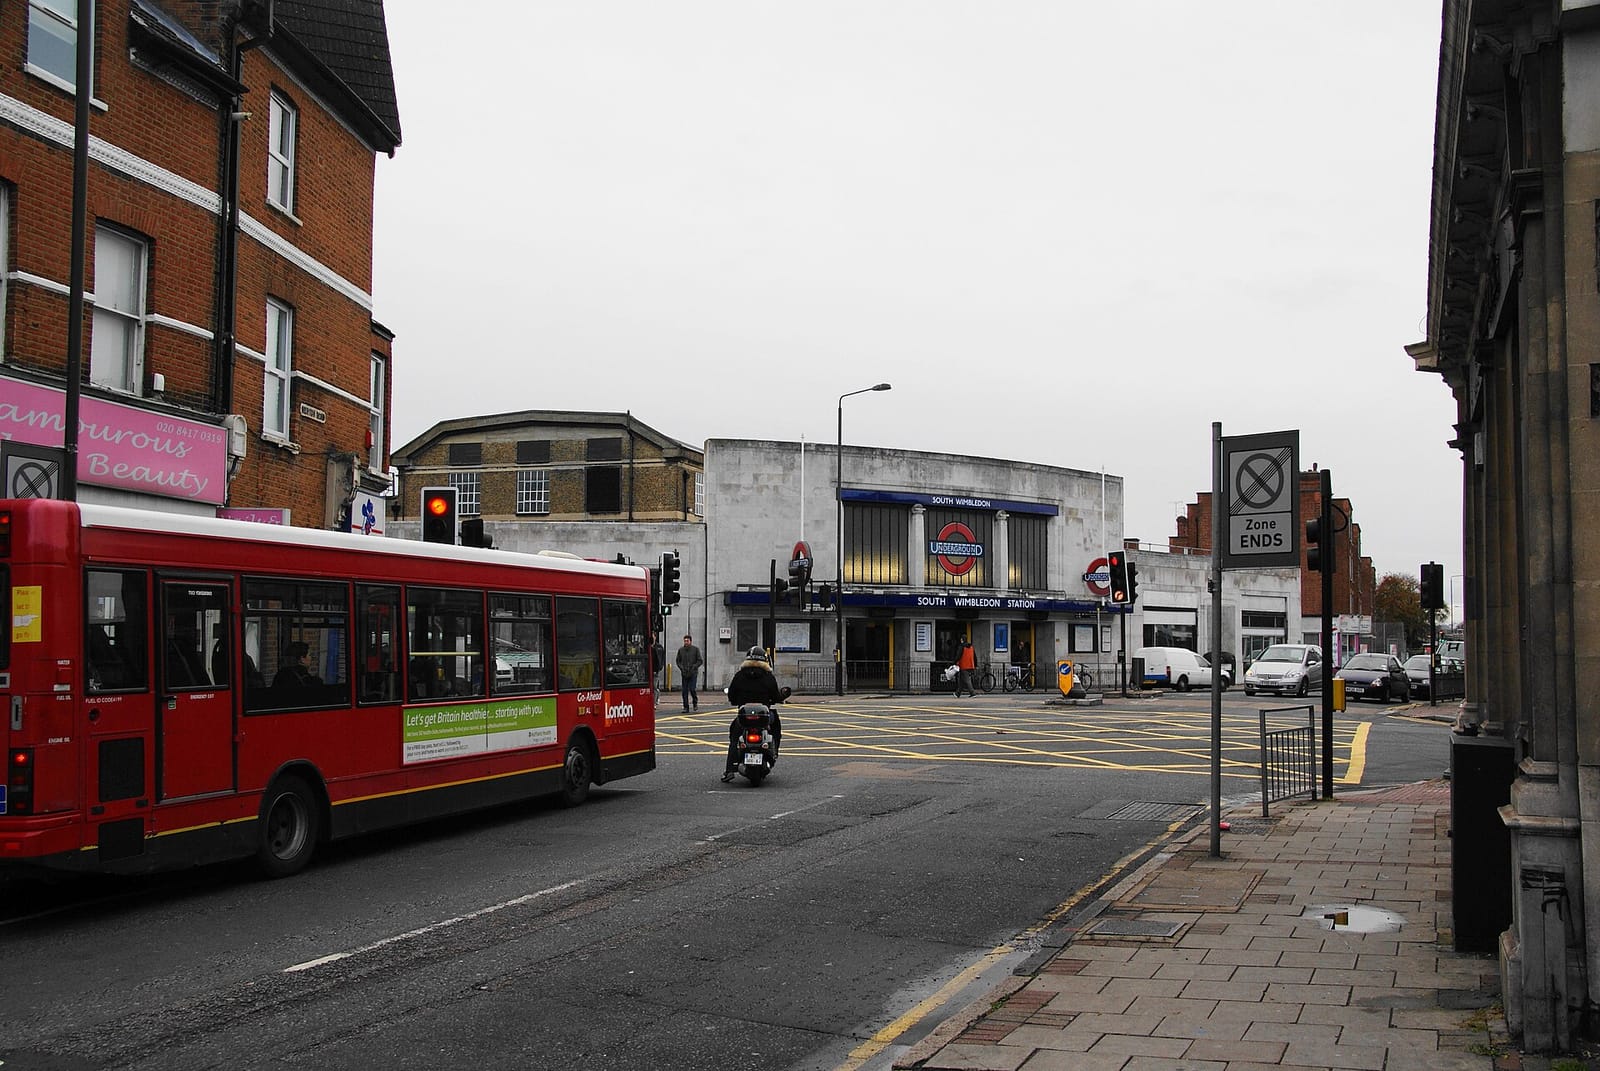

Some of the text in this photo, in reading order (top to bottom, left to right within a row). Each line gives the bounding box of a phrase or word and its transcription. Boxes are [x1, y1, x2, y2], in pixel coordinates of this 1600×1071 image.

[156, 422, 222, 444] 020 8417 0319
[86, 452, 209, 497] Beauty
[932, 496, 991, 508] SOUTH WIMBLEDON
[1246, 519, 1276, 530] Zone
[1240, 533, 1283, 548] ENDS
[930, 541, 983, 556] UNDERGROUND
[917, 596, 1036, 609] SOUTH WIMBLEDON STATION
[407, 713, 424, 727] Let's
[424, 713, 437, 728] get
[437, 709, 460, 724] Britain
[495, 706, 518, 719] starting
[518, 704, 532, 716] with
[605, 701, 633, 719] London
